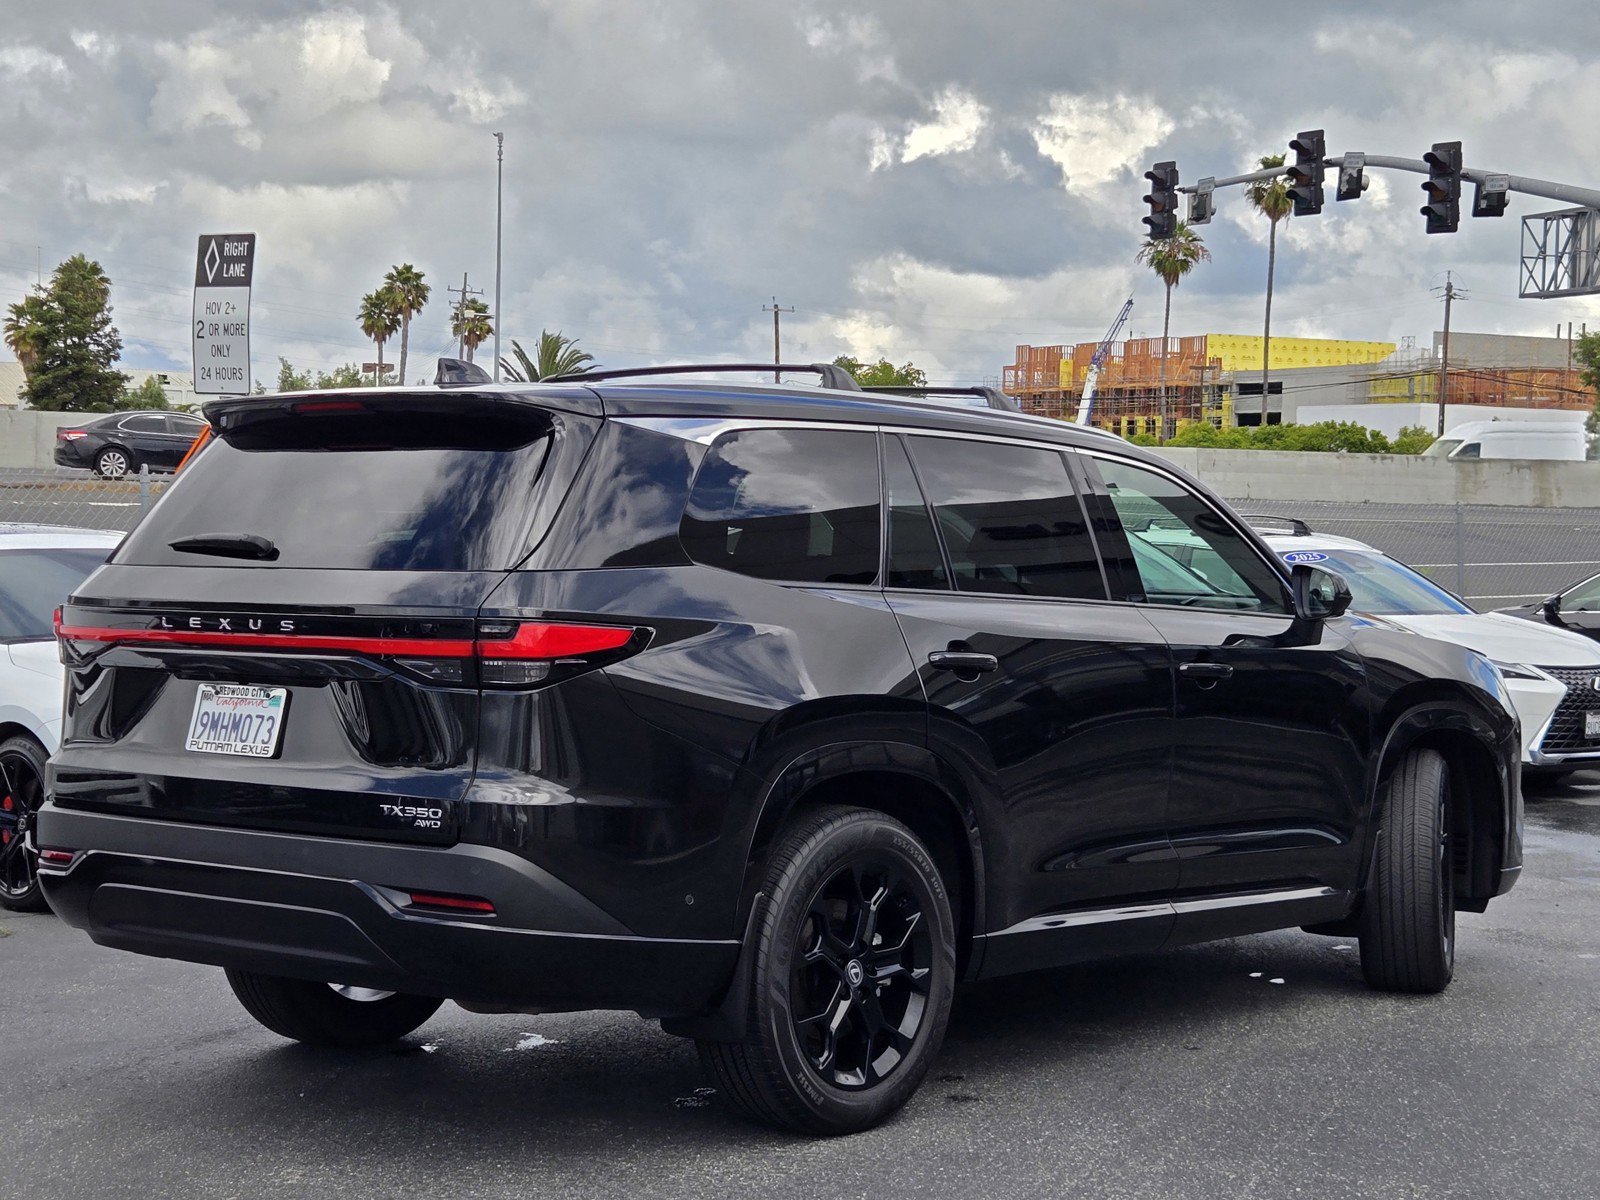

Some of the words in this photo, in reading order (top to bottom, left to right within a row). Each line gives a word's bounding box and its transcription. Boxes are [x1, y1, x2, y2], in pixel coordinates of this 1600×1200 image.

[224, 240, 249, 256] RIGHT
[223, 263, 246, 277] LANE
[205, 301, 222, 315] HOV
[225, 302, 237, 315] 2+
[196, 320, 205, 339] 2
[208, 323, 220, 336] OR
[223, 323, 246, 336] MORE
[211, 344, 231, 357] ONLY
[201, 367, 211, 380] 24
[215, 367, 243, 380] HOURS
[1291, 553, 1321, 561] 2025
[162, 616, 294, 631] LEXUS
[219, 686, 249, 697] REDWOOD
[251, 688, 267, 698] CITY
[216, 697, 264, 711] California
[197, 711, 276, 745] 9MHM073
[189, 740, 233, 752] PUTNAM
[234, 743, 270, 755] LEXUS
[380, 804, 442, 819] TX350
[413, 819, 441, 828] AWD
